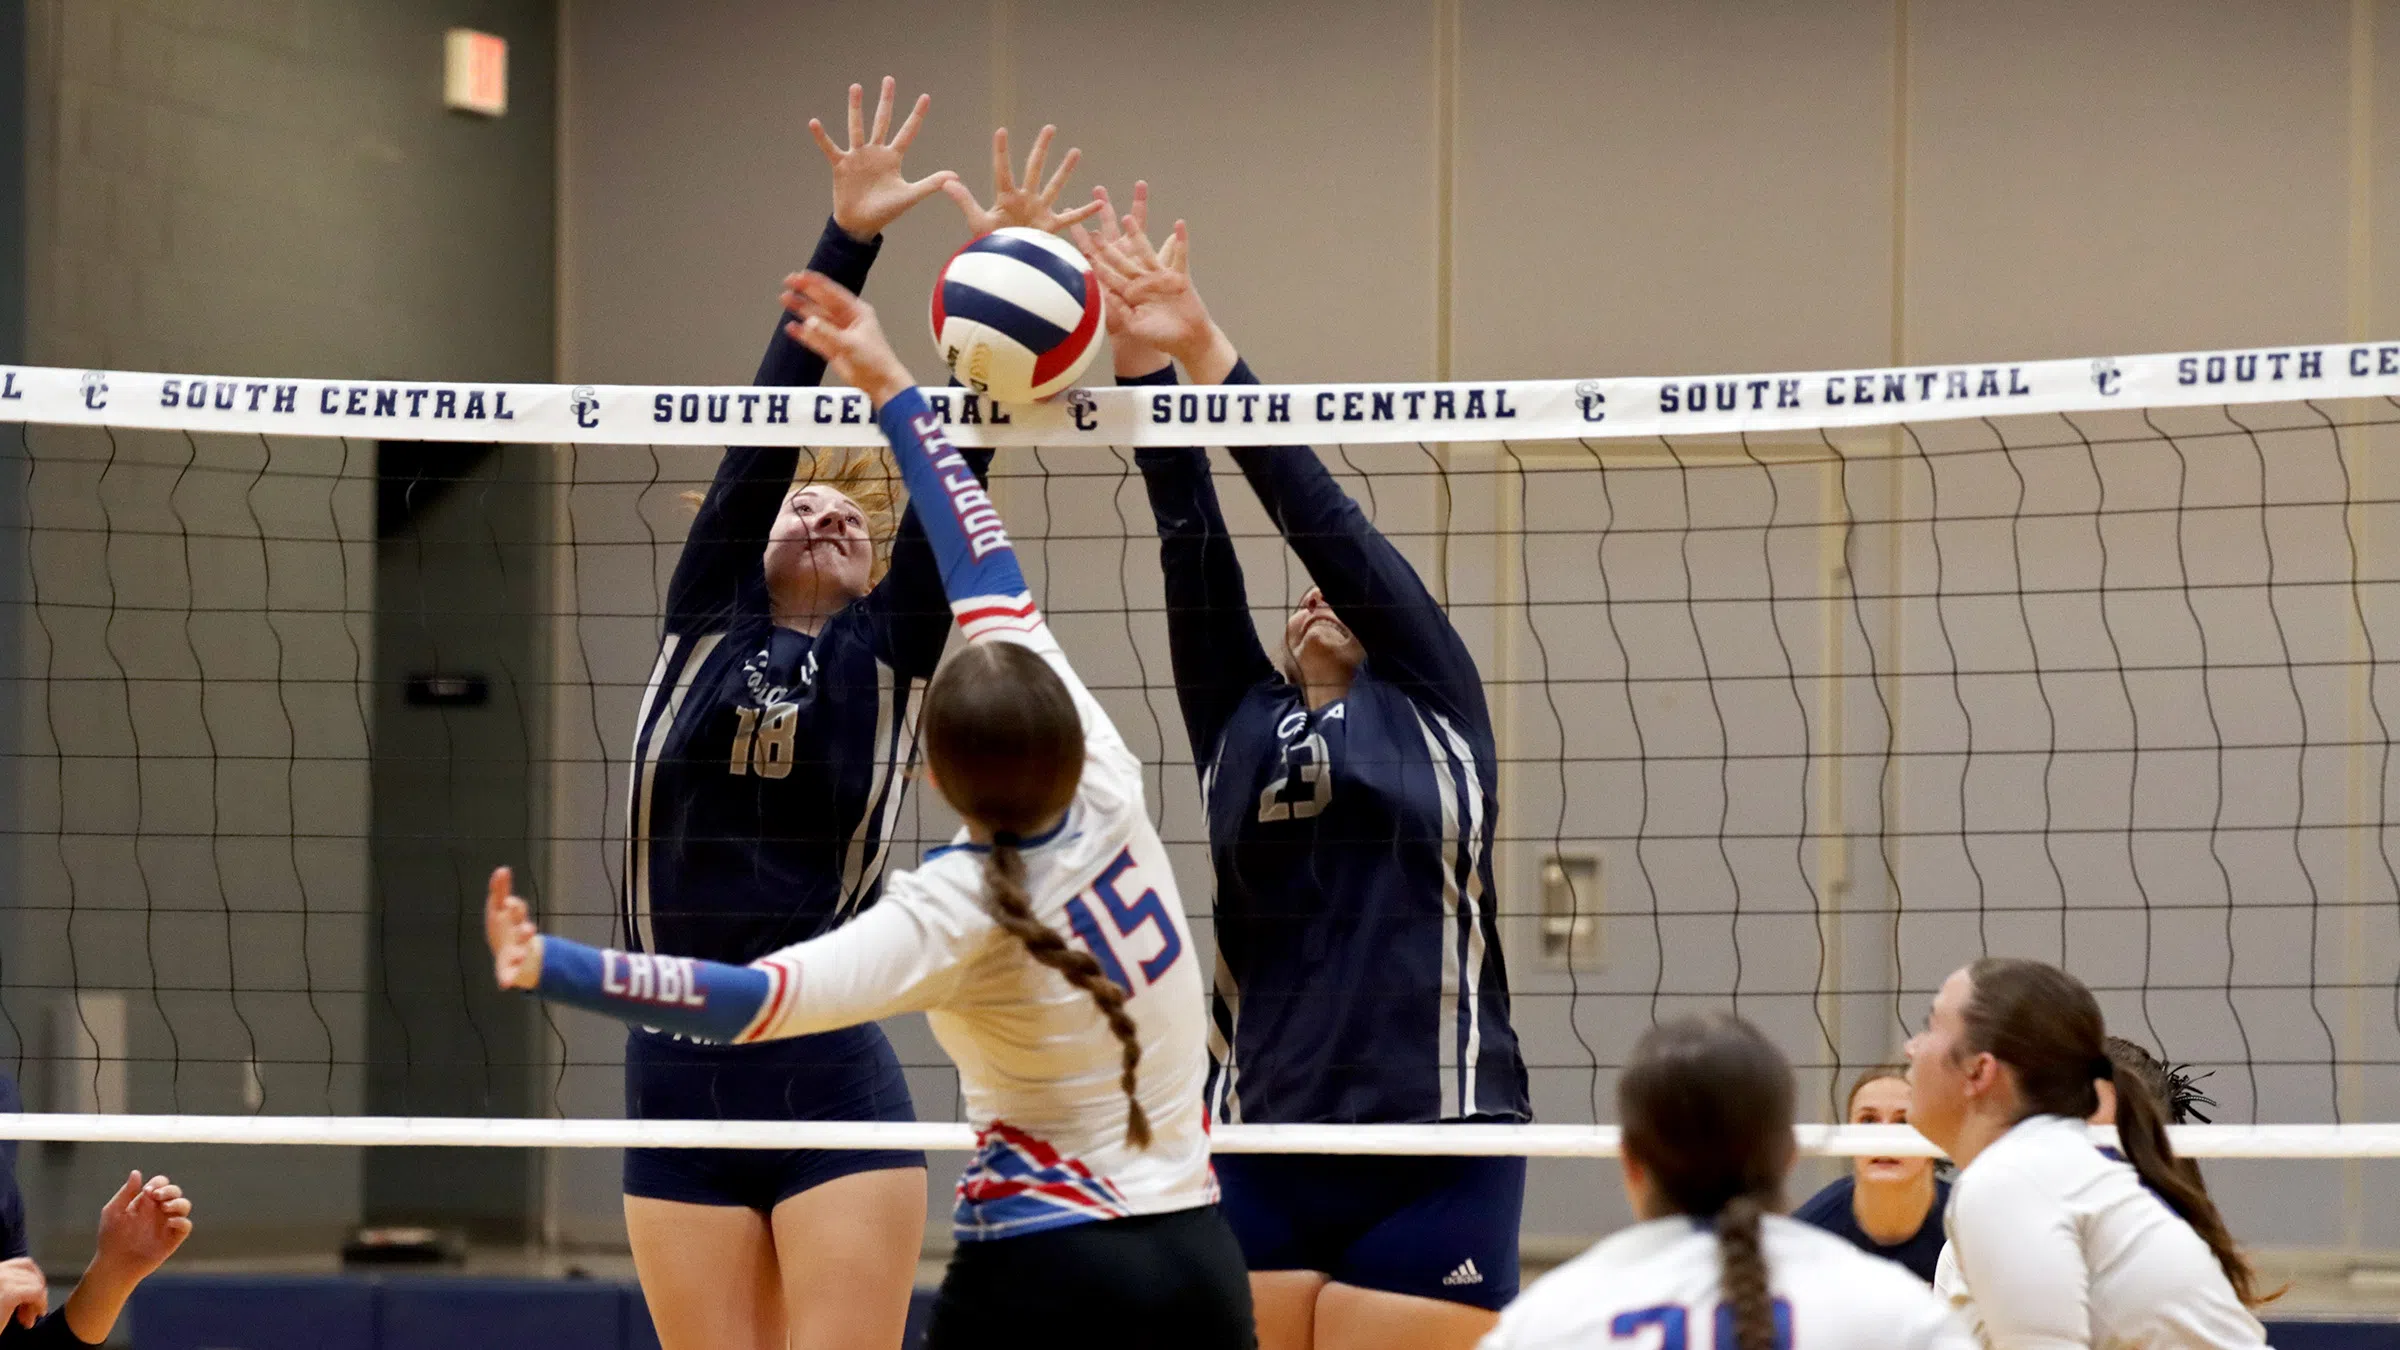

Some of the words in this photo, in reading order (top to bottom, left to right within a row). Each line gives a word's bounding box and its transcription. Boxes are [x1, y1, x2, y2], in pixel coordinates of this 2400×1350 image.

[160, 380, 297, 413] SOUTH
[319, 387, 515, 420] CENTRAL
[653, 394, 790, 424] SOUTH
[813, 394, 1012, 425] CERAL
[1152, 394, 1291, 424] SOUTH
[1315, 388, 1517, 422] CENTRAL
[1659, 374, 1801, 413] SOUTH
[1825, 366, 2031, 407] CENTRAL
[2178, 351, 2322, 385] SOUTH
[729, 701, 800, 779] 18
[1063, 844, 1183, 1000] 15
